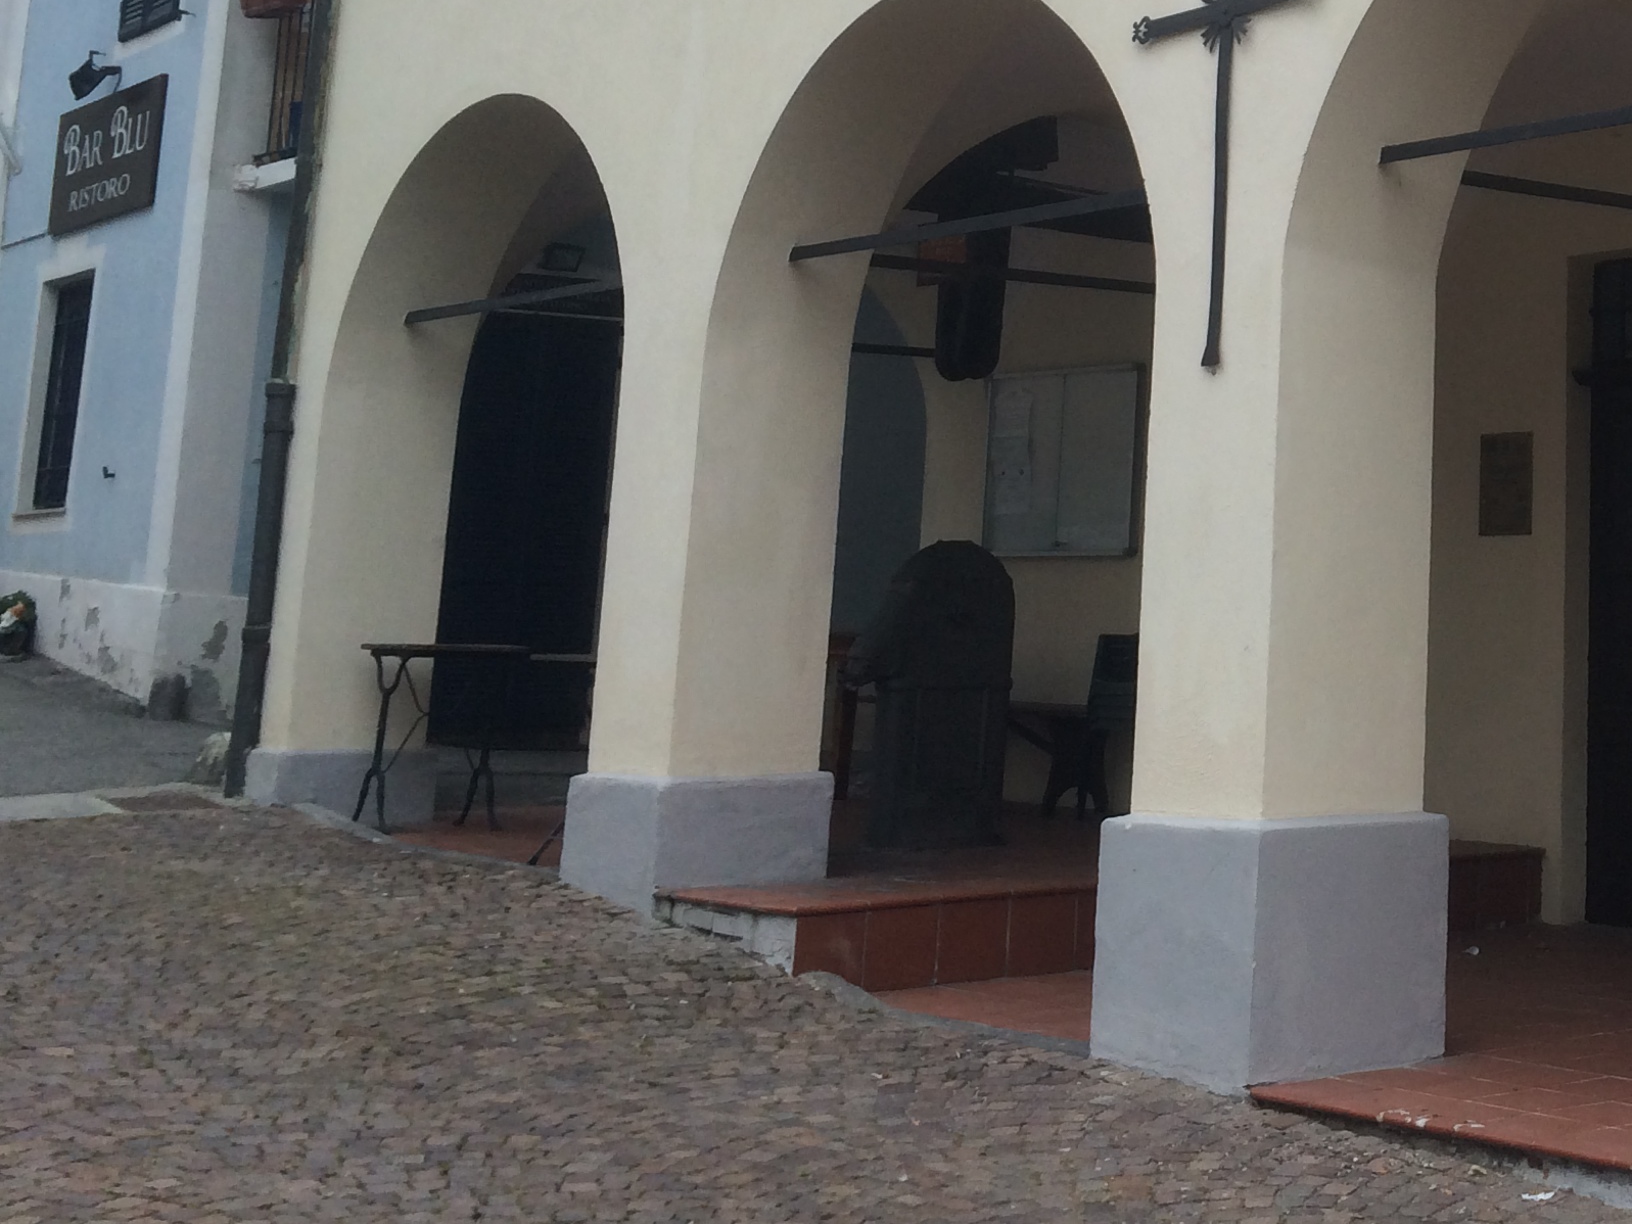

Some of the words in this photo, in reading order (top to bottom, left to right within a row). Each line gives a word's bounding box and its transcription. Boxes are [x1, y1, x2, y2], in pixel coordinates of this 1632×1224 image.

[63, 124, 103, 176] BAR
[110, 105, 150, 159] BLU
[67, 173, 131, 212] RISTORO
